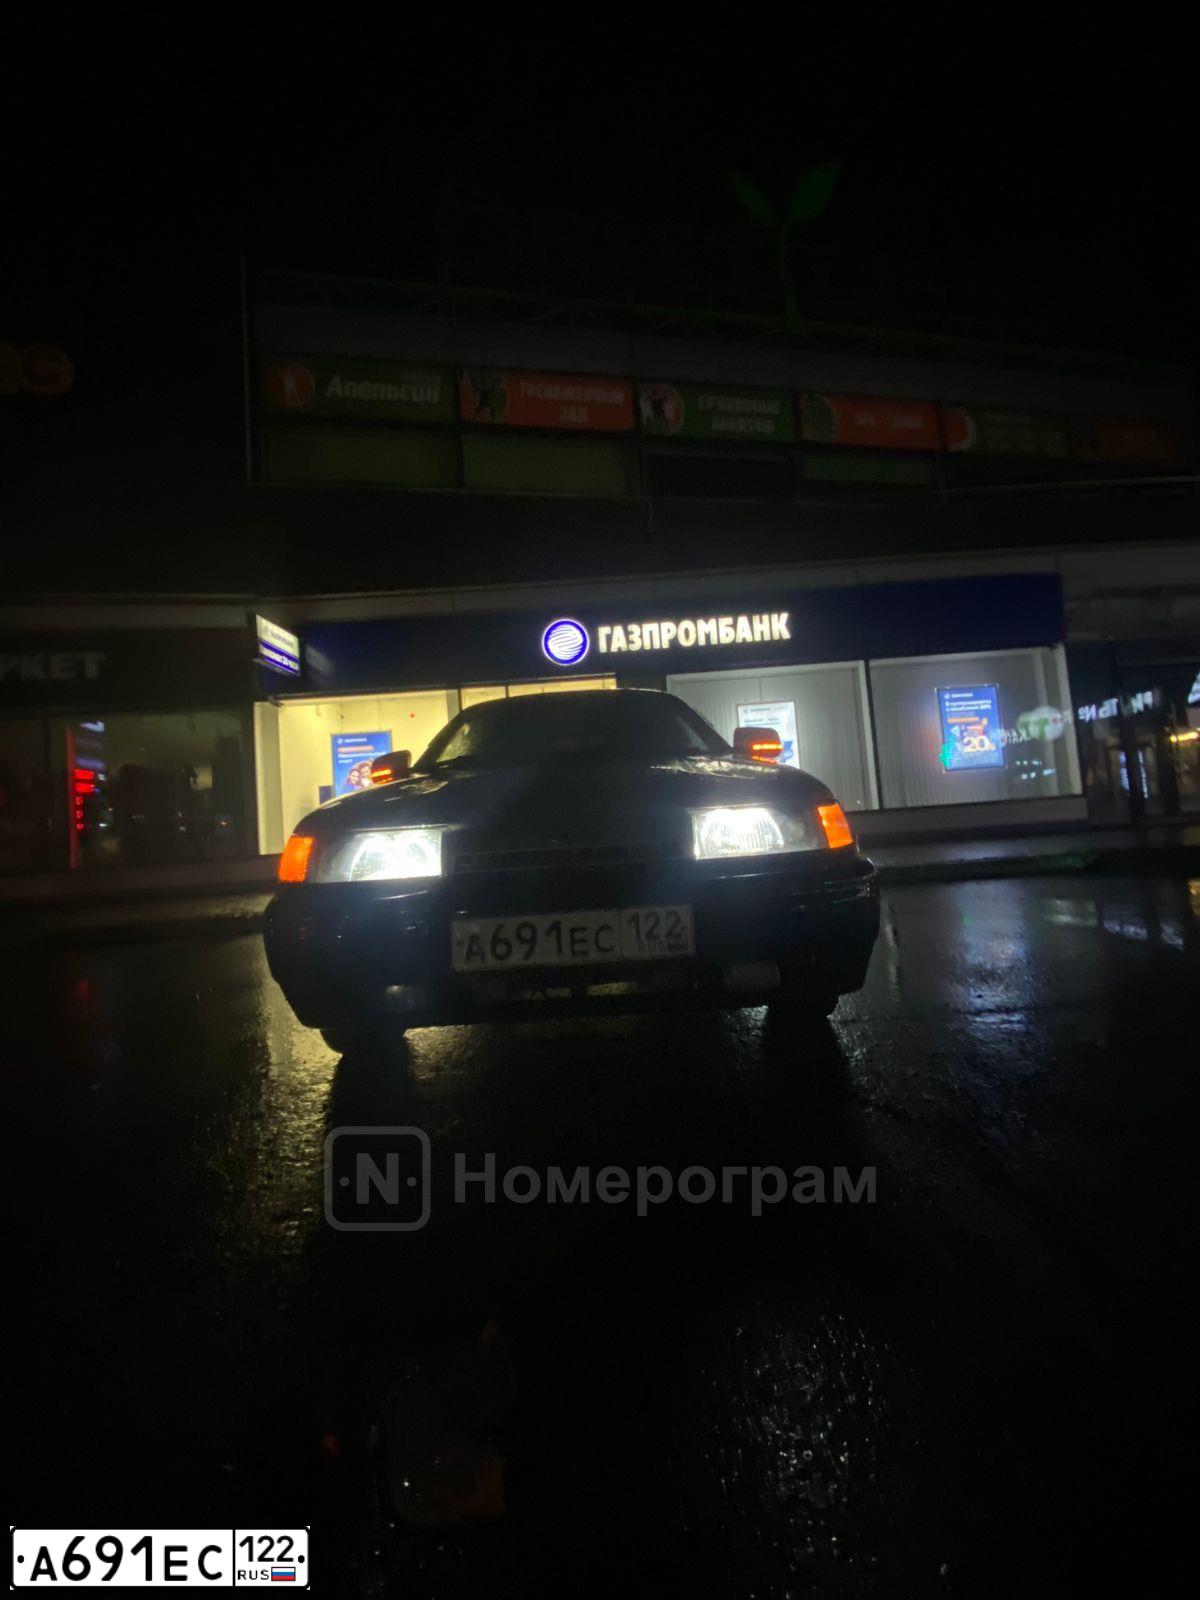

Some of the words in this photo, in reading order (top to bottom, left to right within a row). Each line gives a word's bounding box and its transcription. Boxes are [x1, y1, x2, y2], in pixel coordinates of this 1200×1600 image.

[326, 374, 440, 404] Апельсин
[597, 611, 791, 654] ГАЗПРОМБАНК
[465, 920, 616, 963] А691ЕС
[626, 911, 682, 942] 122
